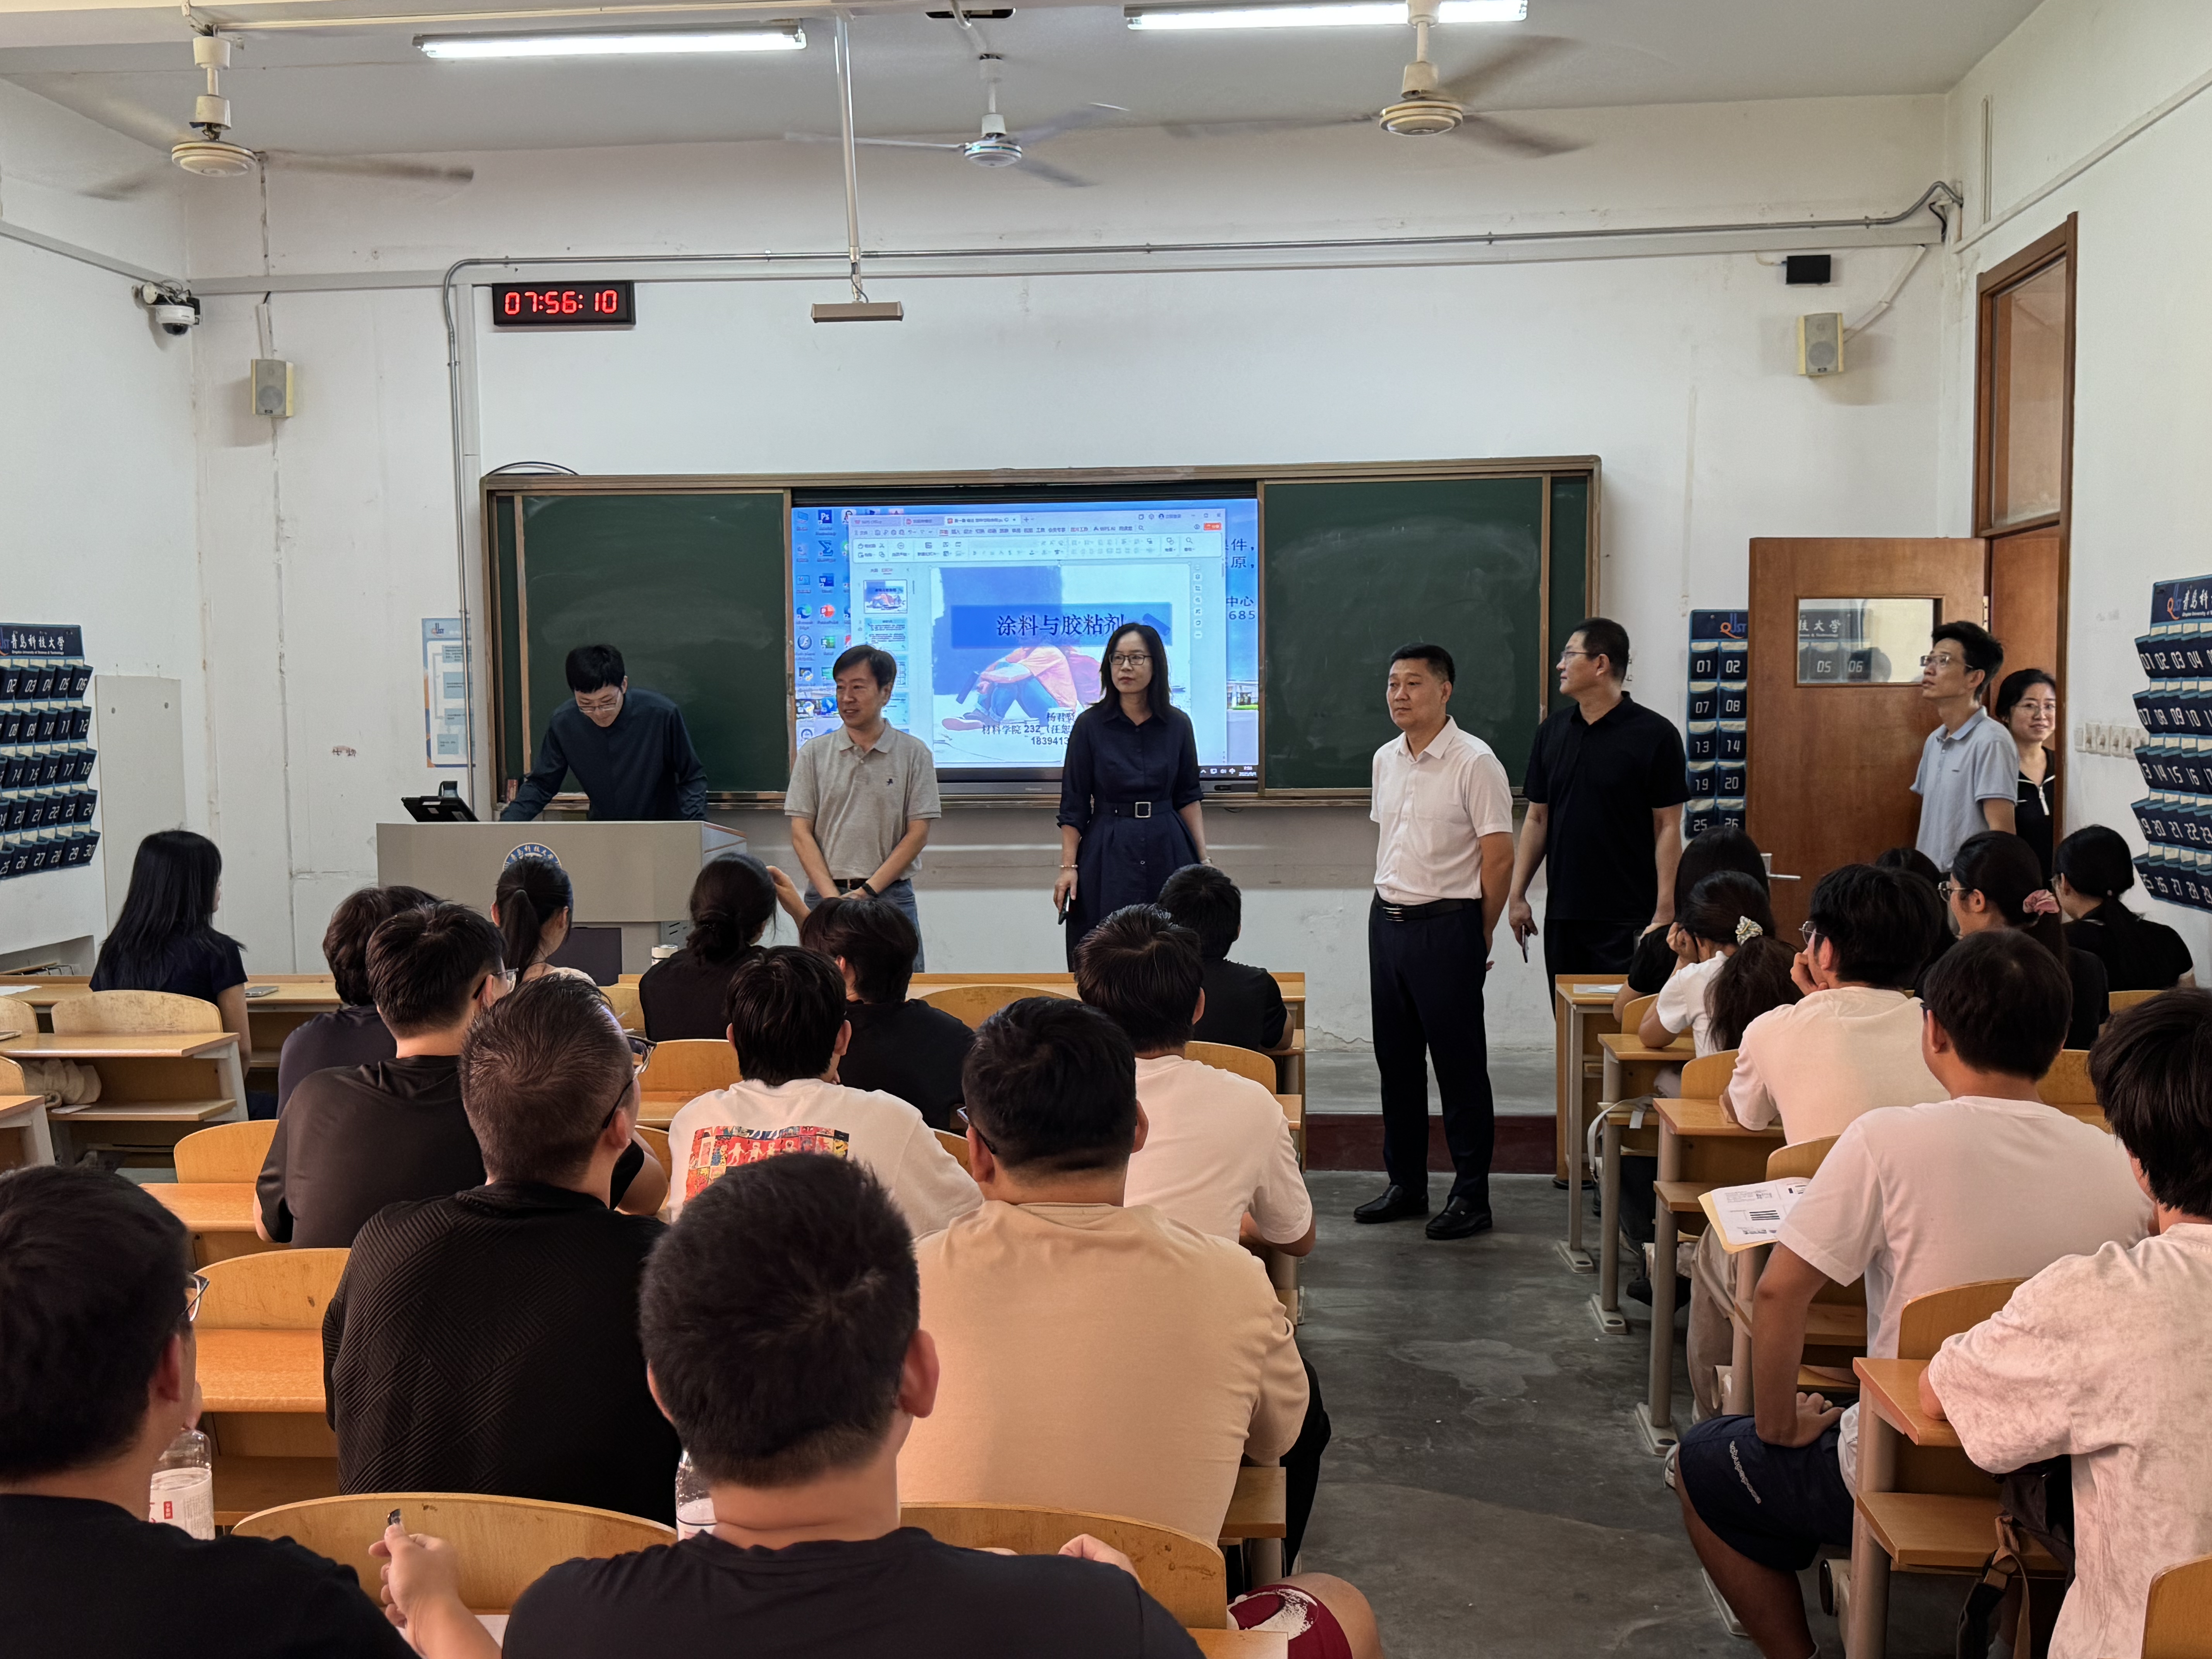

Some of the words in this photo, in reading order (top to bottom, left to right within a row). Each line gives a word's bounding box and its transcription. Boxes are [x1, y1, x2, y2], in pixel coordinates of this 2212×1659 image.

[505, 290, 618, 315] 07:56:10
[1229, 610, 1255, 620] 685
[996, 613, 1125, 636] 涂料与胶粘剂
[2154, 652, 2170, 670] 02
[2171, 651, 2186, 669] 03
[2187, 650, 2204, 669] 04
[1697, 660, 1711, 673] 01
[1726, 660, 1741, 673] 02
[1817, 660, 1832, 673] 05
[1848, 660, 1863, 673] 06
[7, 679, 17, 693] 02
[25, 680, 37, 692] 03
[42, 678, 53, 692] 04
[59, 678, 70, 690] 05
[76, 678, 88, 691] 06
[1695, 701, 1710, 714] 07
[1726, 699, 1741, 712] 08
[2170, 707, 2185, 725] 09
[2185, 709, 2201, 727] 10
[27, 722, 37, 737] 09
[44, 722, 55, 735] 10
[61, 720, 70, 733] 11
[79, 719, 89, 732] 12
[1024, 725, 1041, 733] 232
[1696, 741, 1709, 753] 13
[1727, 740, 1740, 752] 14
[12, 768, 23, 782] 14
[29, 768, 40, 781] 15
[47, 766, 58, 779] 16
[64, 763, 75, 777] 17
[81, 762, 92, 775] 18
[2153, 764, 2168, 781] 14
[2167, 766, 2184, 783] 15
[1724, 776, 1739, 789] 20
[2185, 767, 2200, 786] 16
[1695, 778, 1709, 791] 19
[32, 809, 43, 822] 21
[48, 806, 60, 819] 22
[65, 804, 76, 817] 23
[83, 803, 94, 816] 24
[14, 811, 25, 824] 20
[1693, 819, 1707, 831] 25
[2151, 819, 2167, 836] 20
[2168, 821, 2183, 838] 21
[2184, 823, 2200, 841] 22
[50, 850, 62, 863] 28
[69, 847, 79, 861] 29
[83, 844, 96, 857] 30
[16, 856, 28, 869] 26
[34, 852, 46, 866] 27
[2171, 878, 2183, 896] 27
